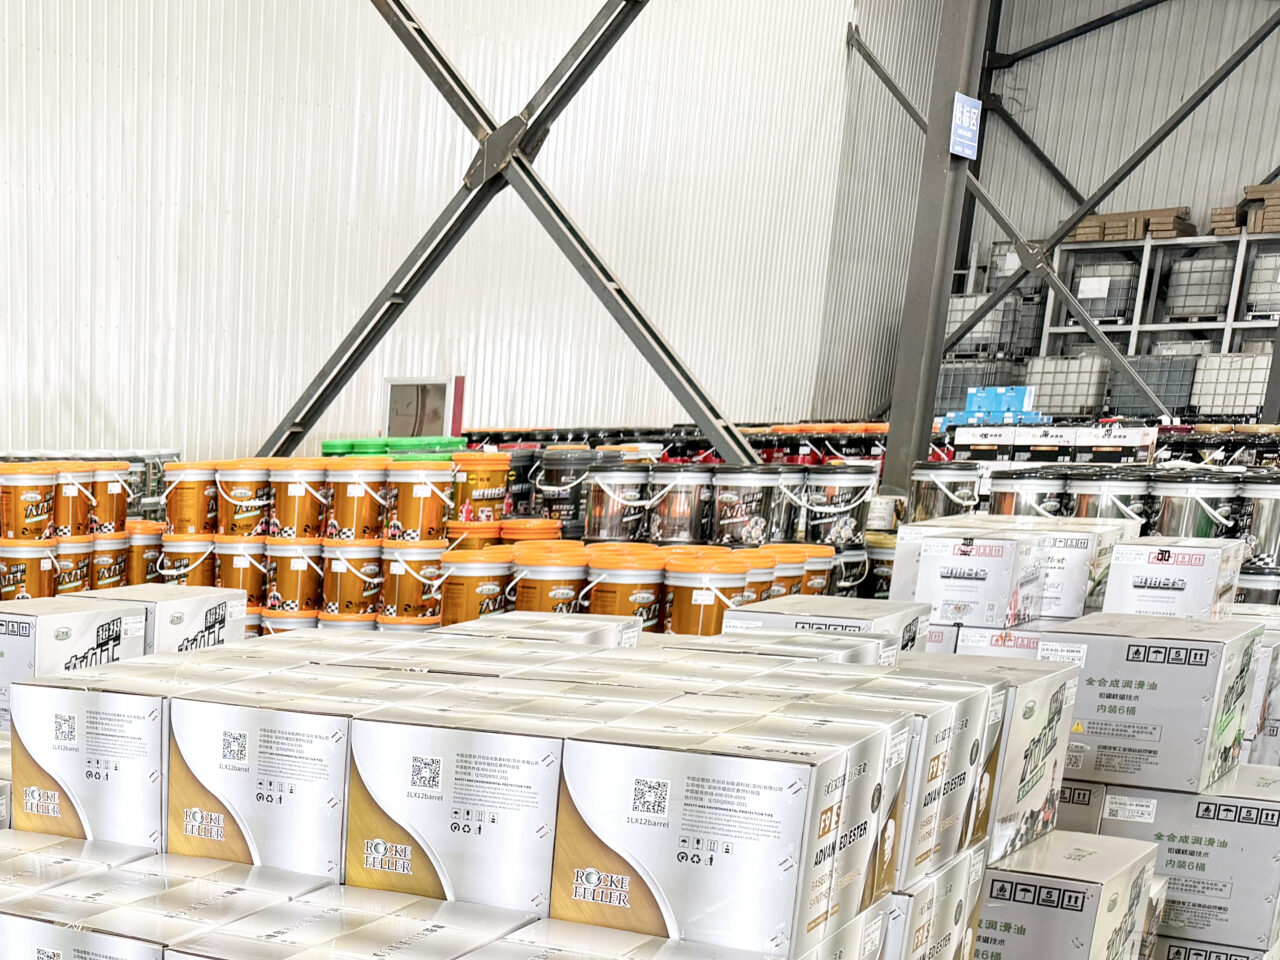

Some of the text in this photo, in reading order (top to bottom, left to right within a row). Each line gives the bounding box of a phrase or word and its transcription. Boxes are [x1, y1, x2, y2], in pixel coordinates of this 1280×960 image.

[1085, 676, 1158, 692] 全合成润滑油
[1096, 704, 1137, 716] 内装6桶
[365, 838, 411, 859] ROCKE
[1153, 831, 1228, 849] 全合成润滑油
[814, 833, 848, 868] ADVANED
[364, 854, 412, 874] FELLER
[1165, 858, 1207, 872] 内装6桶
[575, 868, 629, 890] ROCKE
[573, 886, 629, 907] FELLER
